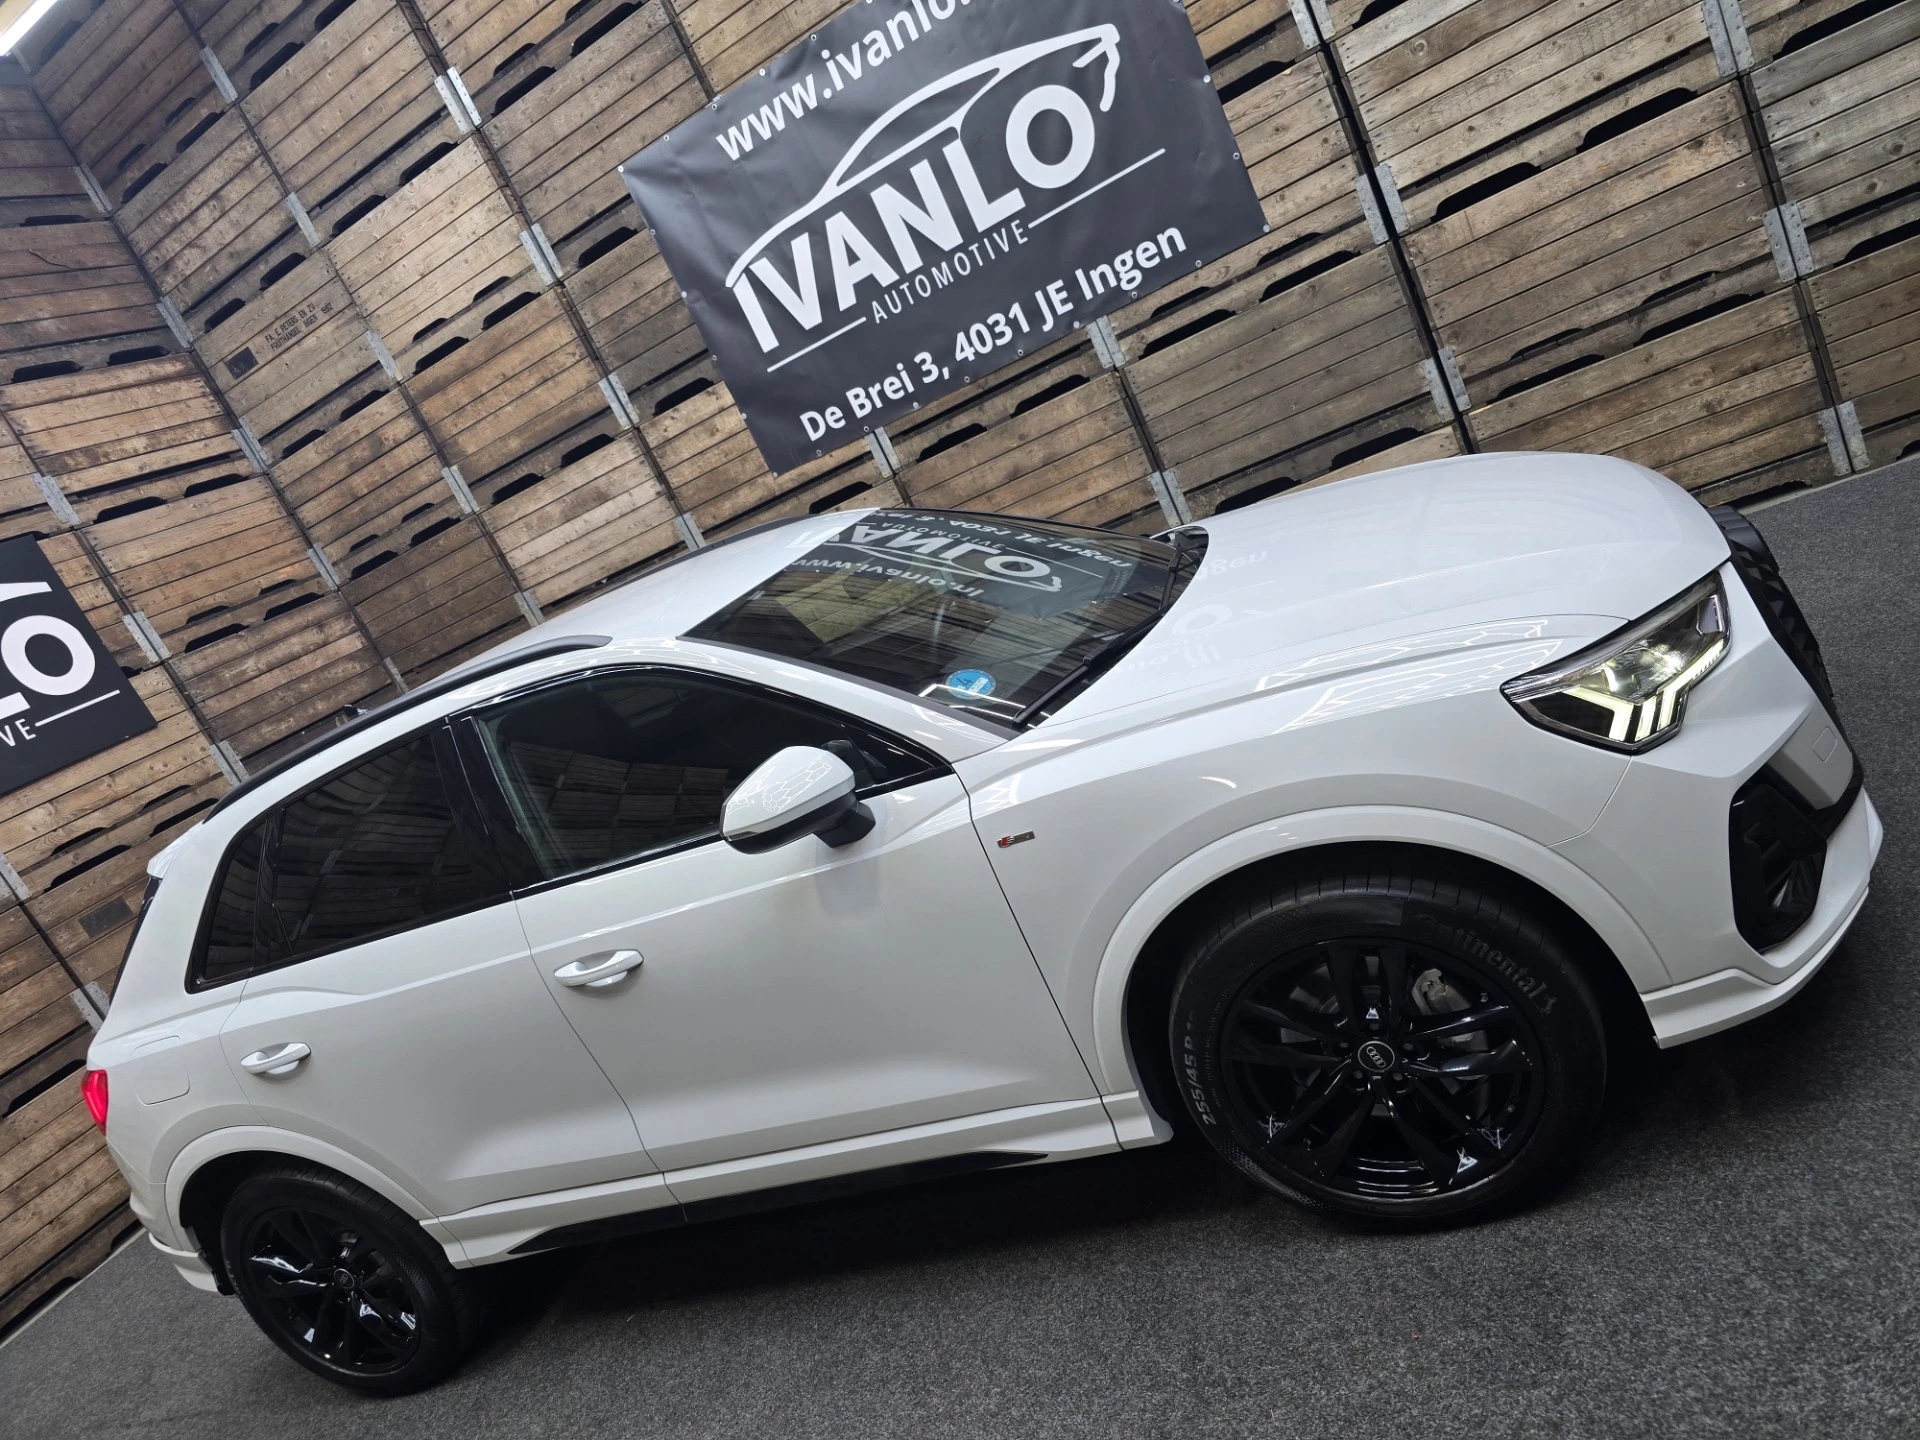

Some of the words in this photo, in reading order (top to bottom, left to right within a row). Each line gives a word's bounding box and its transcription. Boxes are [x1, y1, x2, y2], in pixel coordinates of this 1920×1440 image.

[732, 85, 1095, 353] IVANLO
[872, 219, 1028, 325] AUTOMOTIVE
[800, 407, 846, 441] De
[845, 360, 915, 419] Brei
[914, 352, 950, 380] 3,
[954, 303, 1030, 362] 4031
[1035, 280, 1074, 332] JE
[1074, 228, 1187, 301] Ingen
[1184, 1053, 1217, 1125] 255/45
